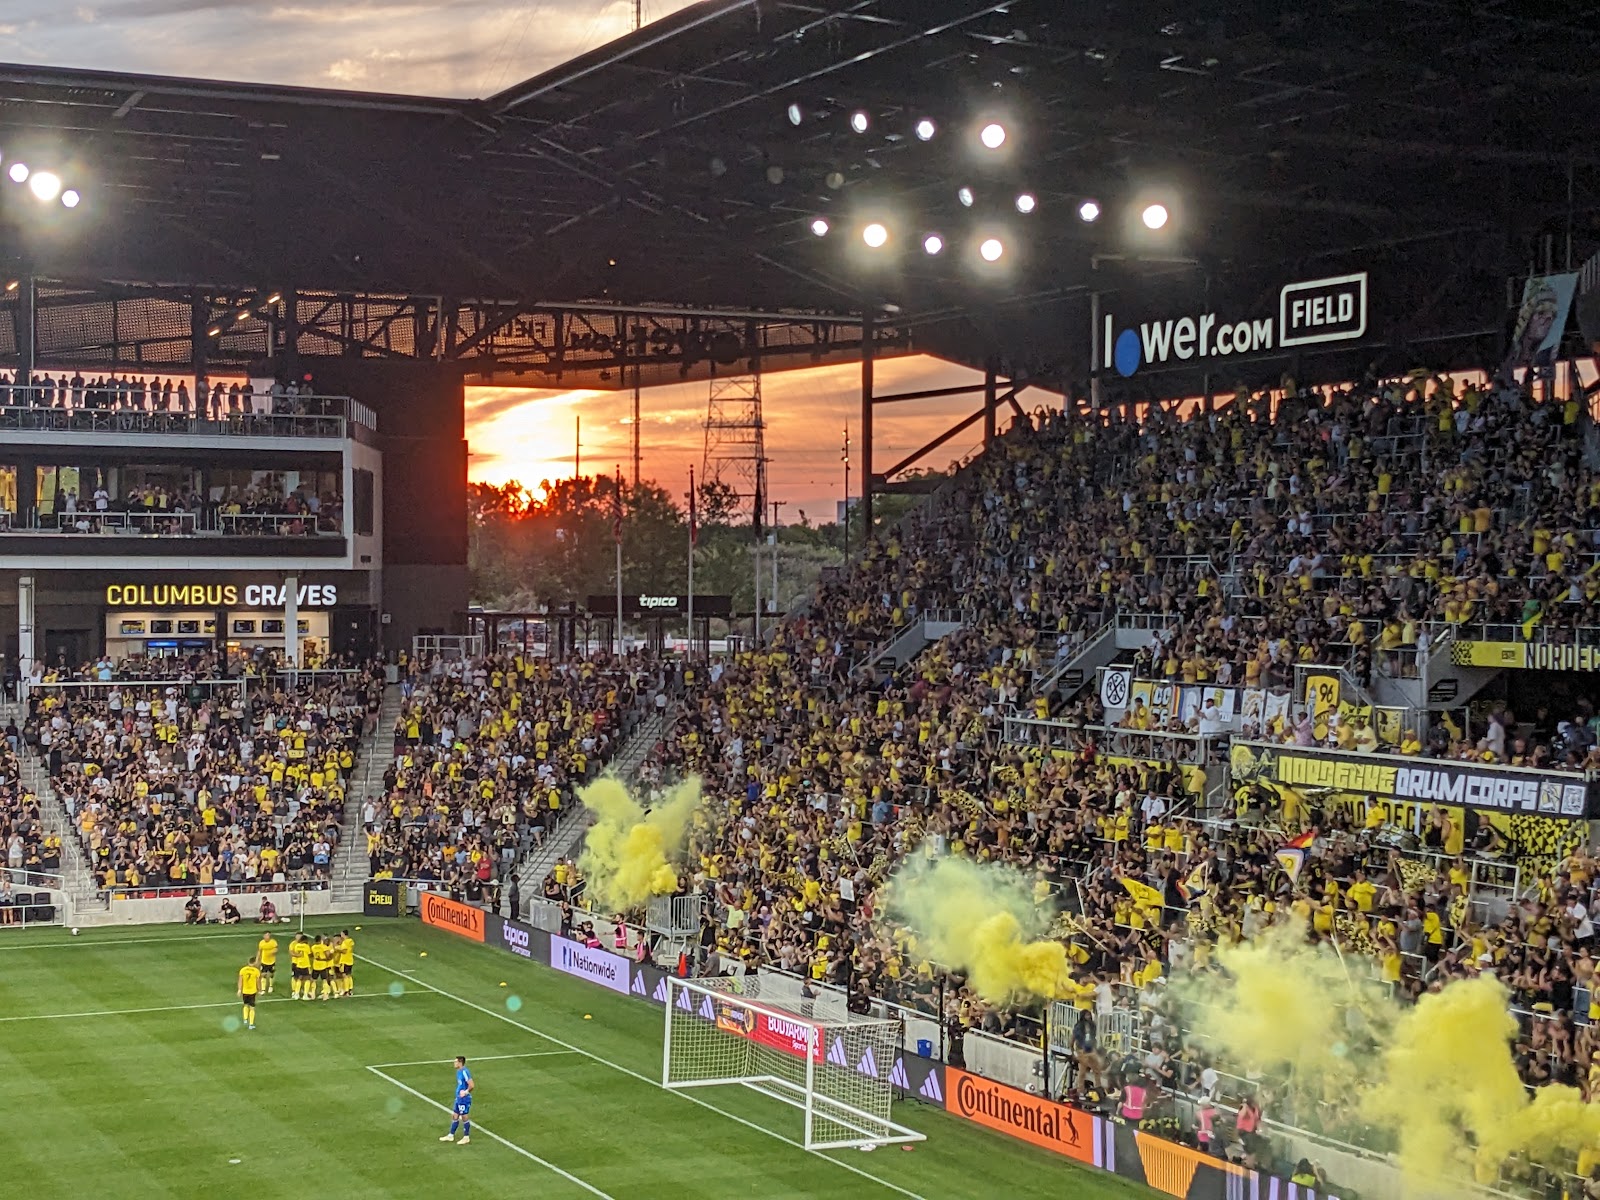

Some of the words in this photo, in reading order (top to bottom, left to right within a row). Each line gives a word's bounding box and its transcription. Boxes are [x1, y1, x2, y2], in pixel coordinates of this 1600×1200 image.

[1292, 293, 1354, 329] FIELD
[106, 585, 238, 606] COLUMBUS
[639, 593, 678, 609] tipico
[1320, 683, 1333, 703] 96
[369, 894, 393, 905] CREW
[427, 896, 471, 930] Continental
[502, 919, 530, 948] tipico
[573, 951, 615, 981] Nationwide
[957, 1075, 1063, 1142] Continental
